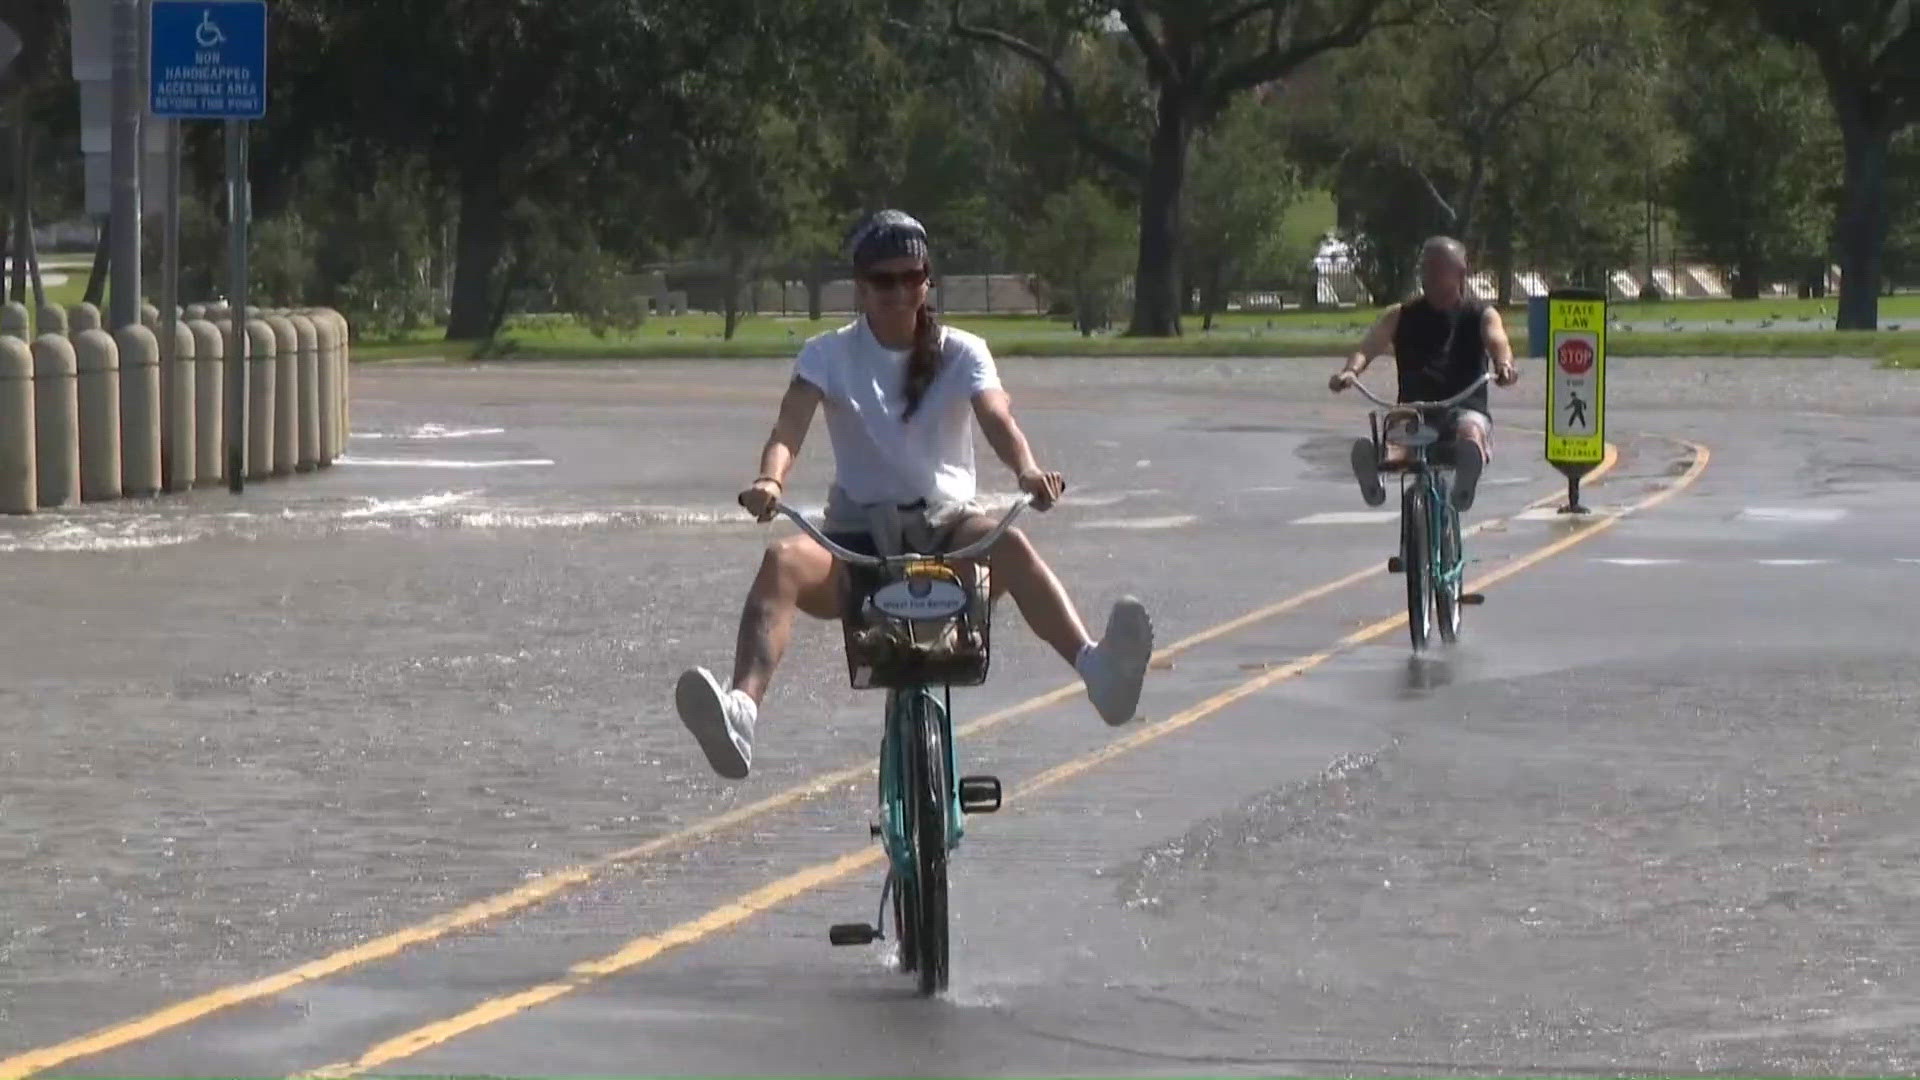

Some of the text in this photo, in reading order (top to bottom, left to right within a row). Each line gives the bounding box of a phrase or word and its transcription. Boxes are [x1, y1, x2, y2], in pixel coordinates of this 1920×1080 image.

[195, 52, 220, 64] NON
[165, 67, 250, 79] HANDICAPPED
[227, 83, 257, 95] AREA
[1559, 304, 1595, 315] STATE
[1564, 317, 1589, 329] LAW
[1559, 348, 1593, 365] STOP
